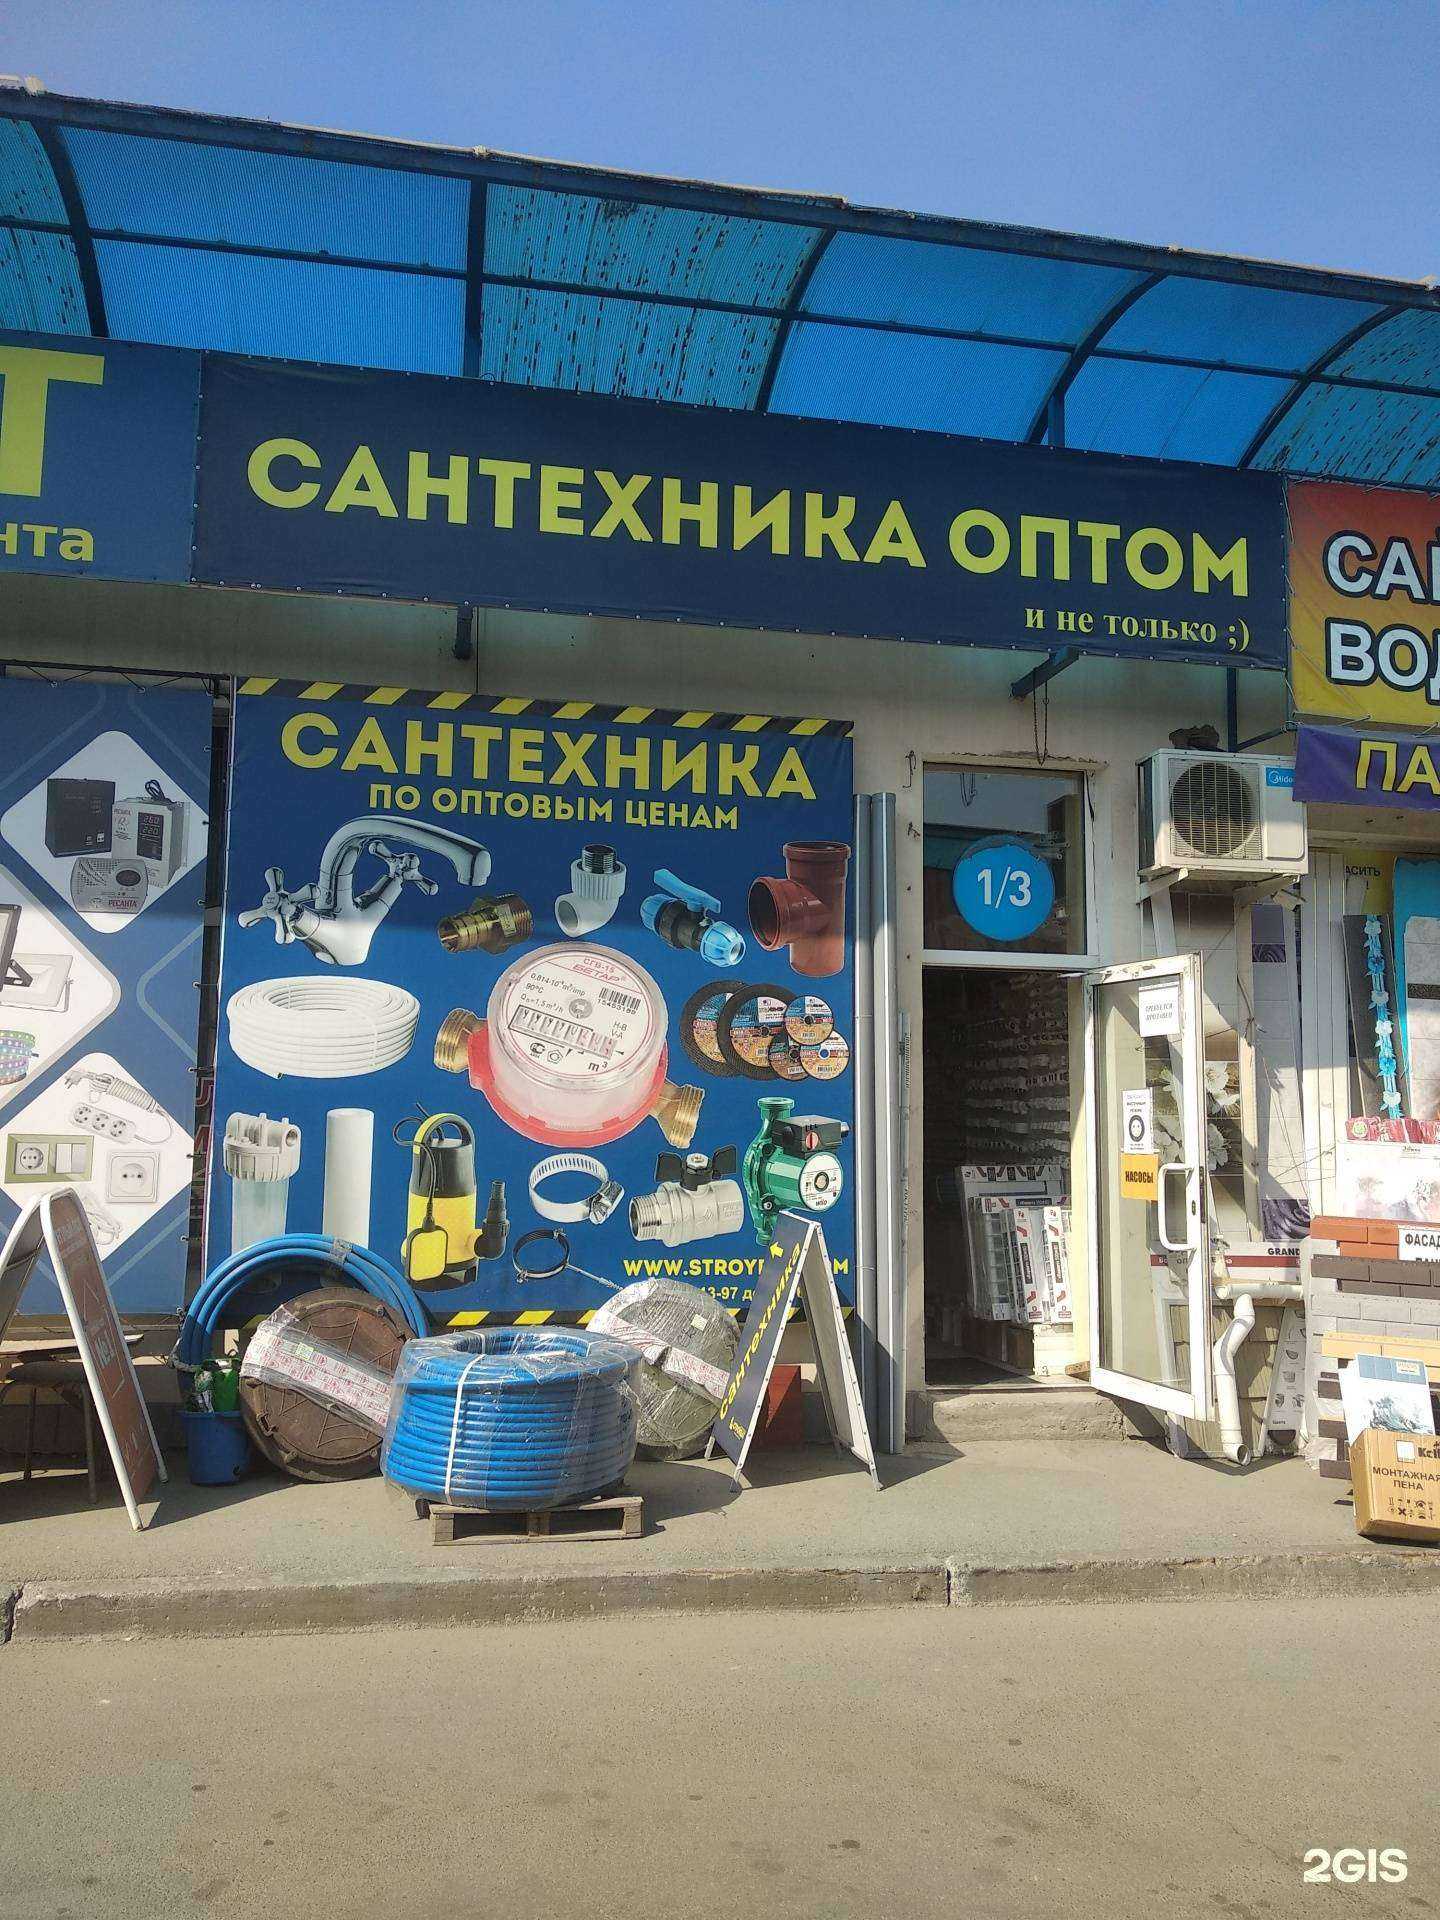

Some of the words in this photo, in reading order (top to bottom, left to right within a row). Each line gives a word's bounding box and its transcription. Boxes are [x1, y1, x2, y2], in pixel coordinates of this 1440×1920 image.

[0, 346, 104, 497] Т
[248, 438, 926, 569] САНТЕХНИКА
[948, 508, 1249, 597] ОПТОМ
[1323, 530, 1440, 606] СА
[1025, 608, 1045, 629] и
[1057, 610, 1094, 633] не
[1104, 614, 1217, 643] только
[281, 713, 816, 801] САНТЕХНИКА
[1356, 740, 1440, 796] ПА
[369, 783, 421, 811] ПО
[432, 787, 613, 823] ОПТОВЫМ
[625, 800, 739, 831] ЦЕНАМ
[977, 866, 1032, 908] 1/3
[1345, 865, 1381, 877] АСИТЬ
[1125, 1171, 1154, 1184] НАСОСЫ
[1393, 1479, 1424, 1491] ПЕНА
